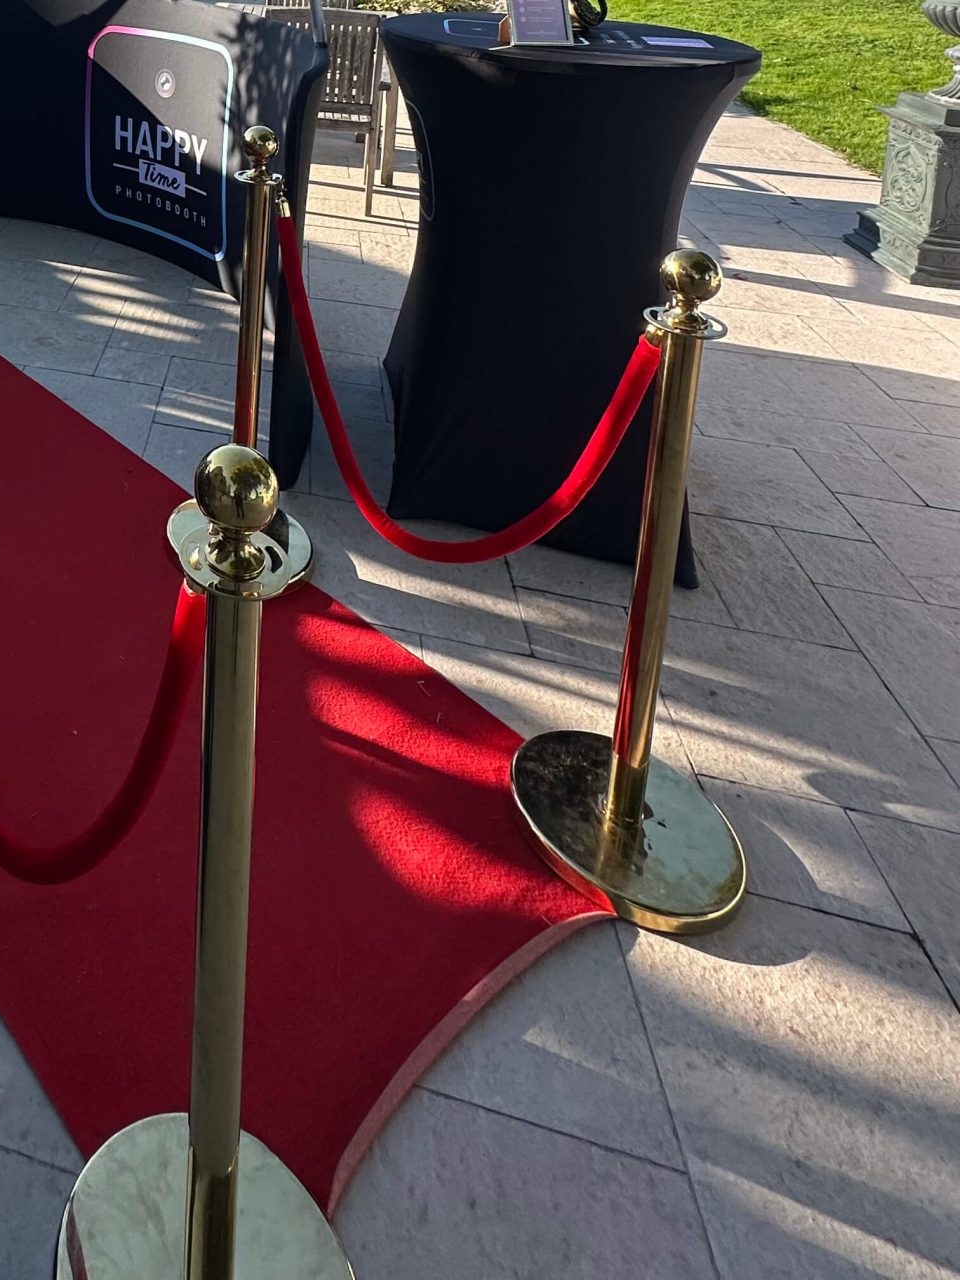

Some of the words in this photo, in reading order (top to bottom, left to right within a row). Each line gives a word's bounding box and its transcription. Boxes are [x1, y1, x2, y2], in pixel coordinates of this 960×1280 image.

[115, 115, 208, 175] HAPPY
[142, 161, 181, 190] Time
[115, 185, 207, 228] PHOTOBOOTH
